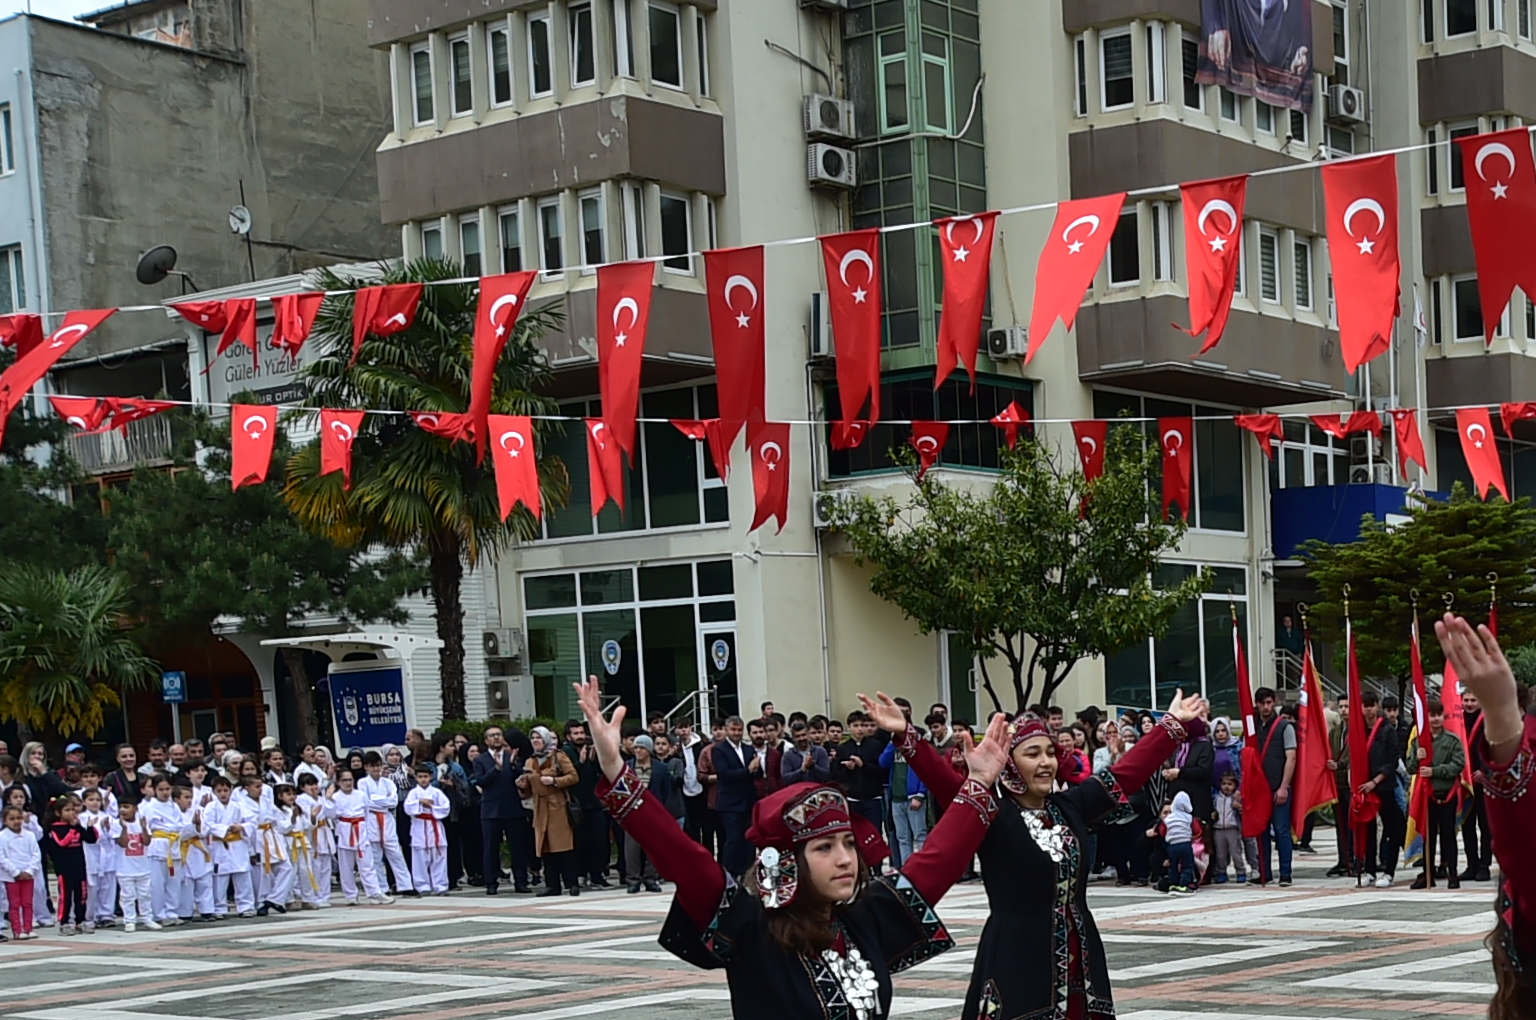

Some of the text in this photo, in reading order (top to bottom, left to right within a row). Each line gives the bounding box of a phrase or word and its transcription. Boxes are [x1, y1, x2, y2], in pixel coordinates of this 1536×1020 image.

[225, 364, 261, 382] Gülen
[275, 388, 303, 402] OPTİK
[366, 692, 401, 705] BURSA
